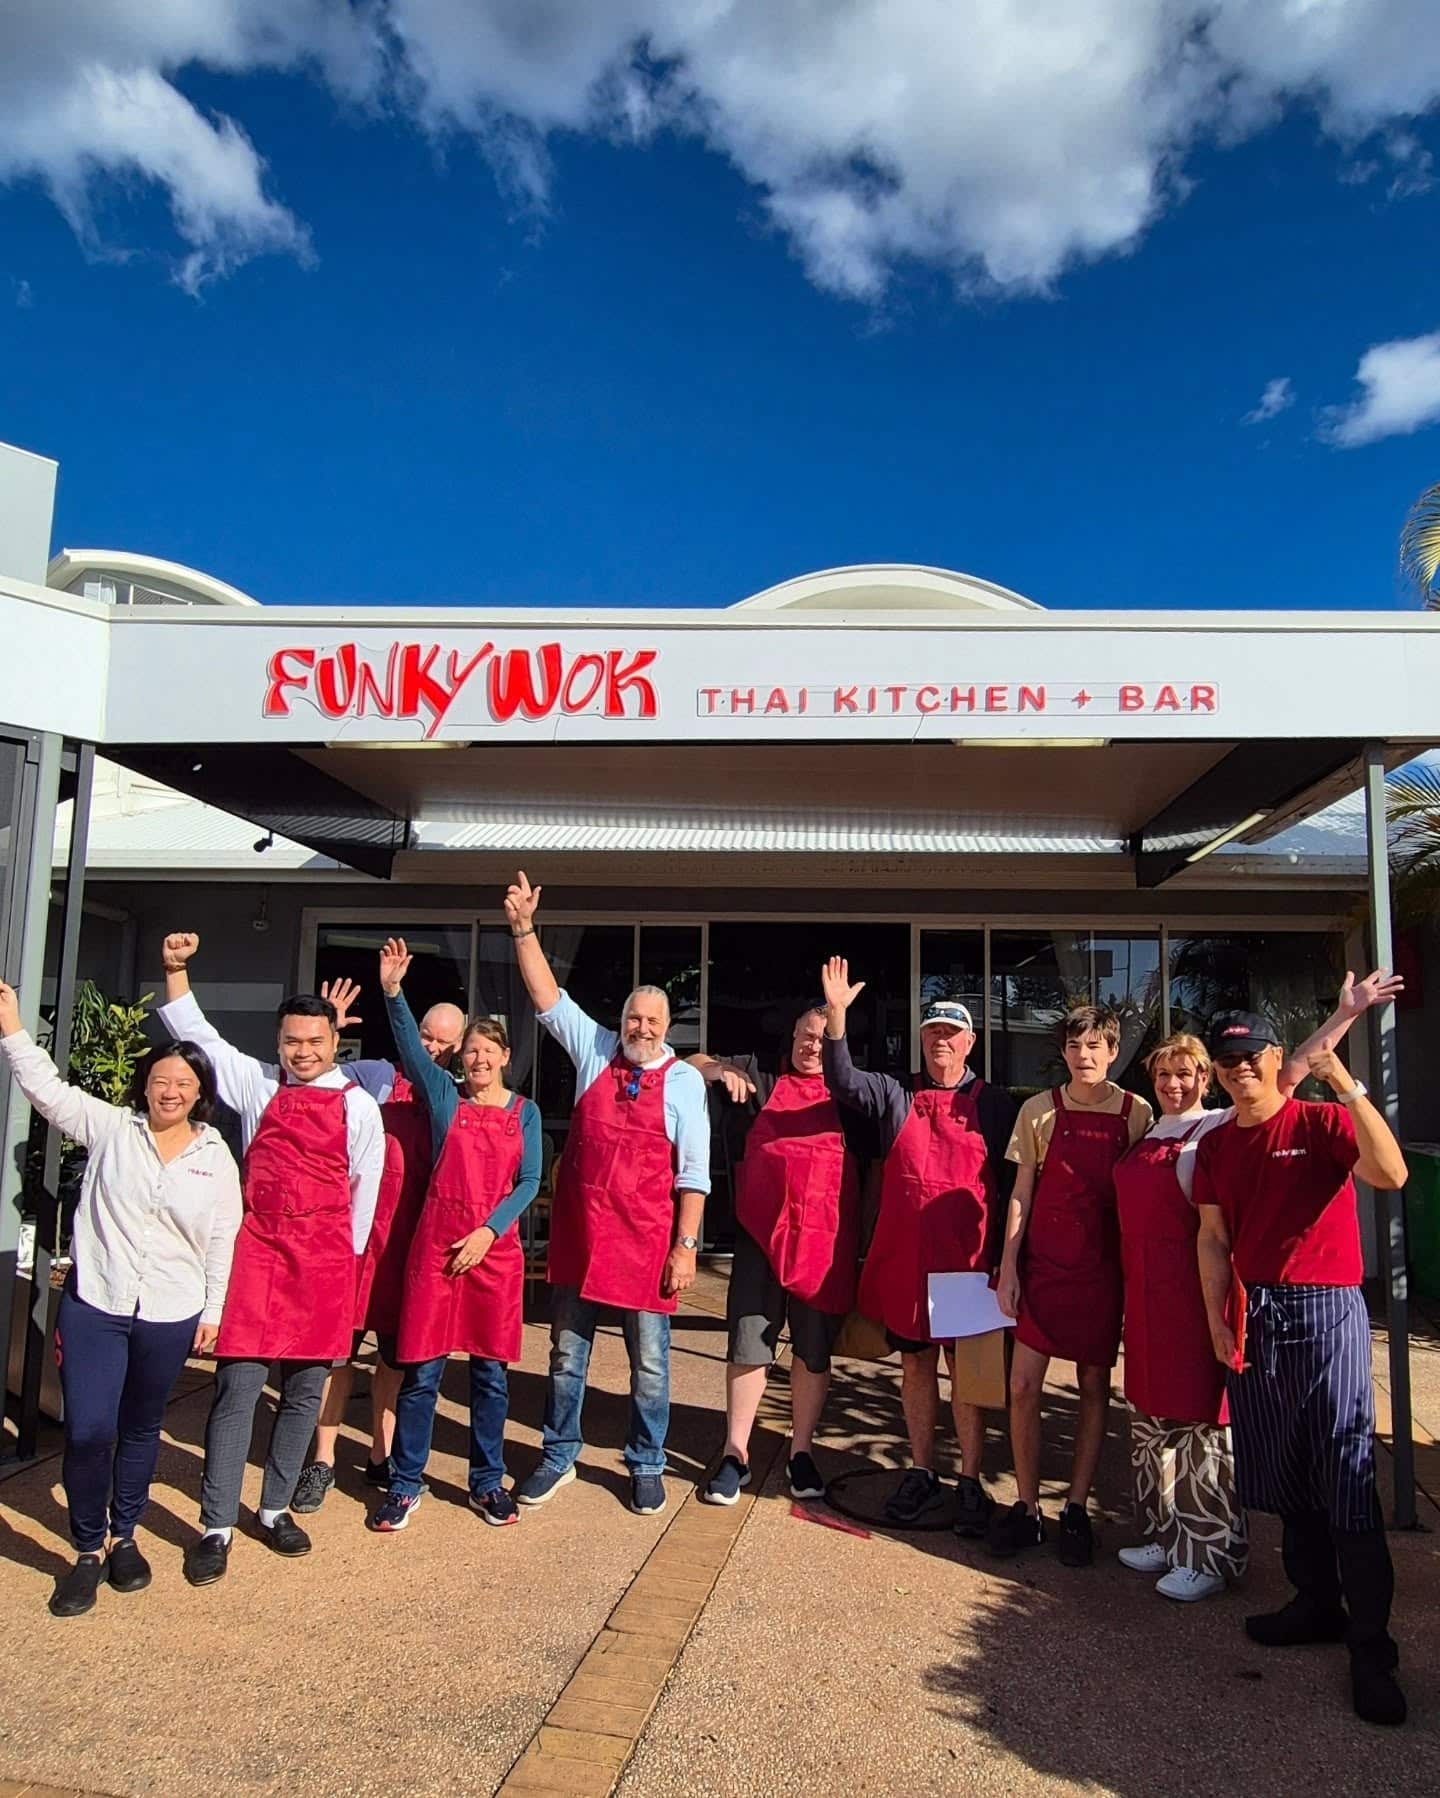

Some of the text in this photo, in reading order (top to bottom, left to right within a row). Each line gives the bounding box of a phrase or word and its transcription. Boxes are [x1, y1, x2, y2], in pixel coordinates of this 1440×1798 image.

[700, 684, 1216, 714] THAI KITCHEN + BAR
